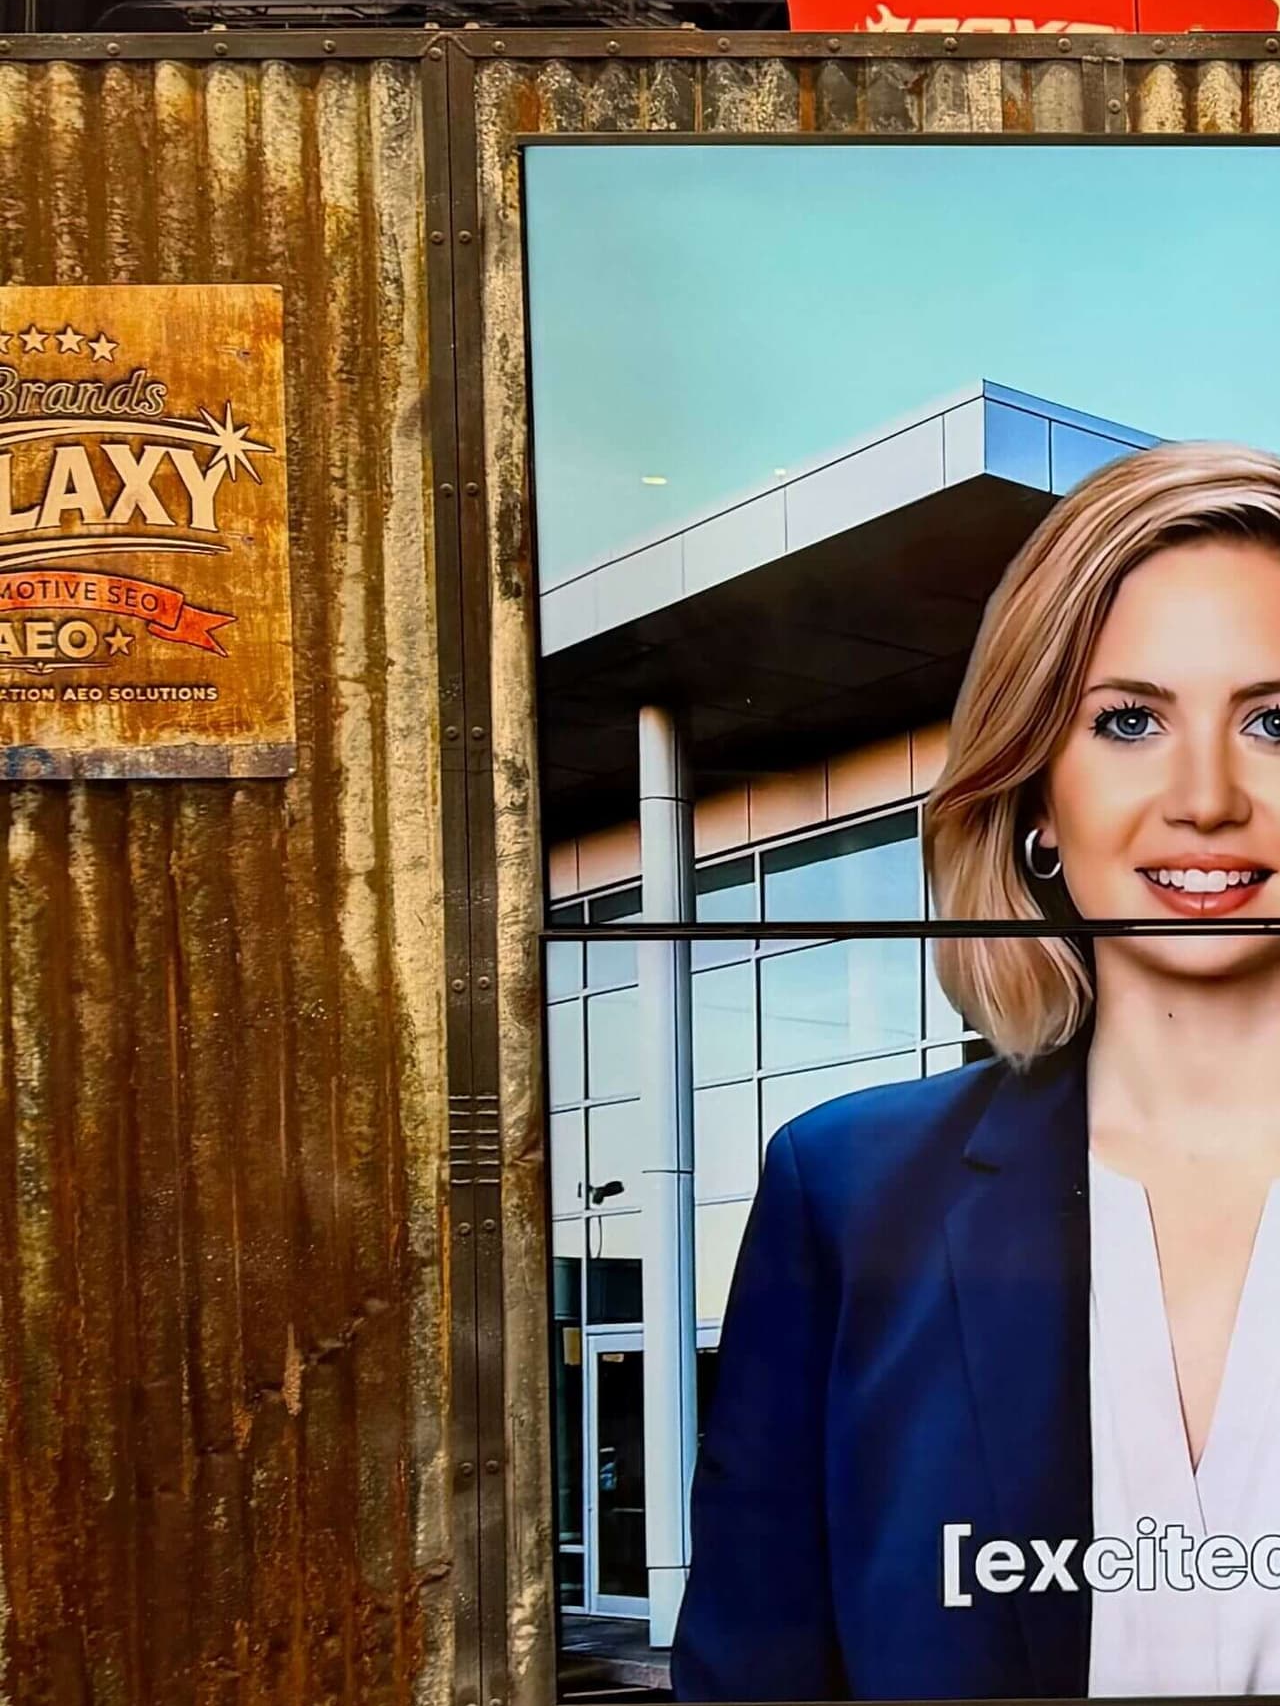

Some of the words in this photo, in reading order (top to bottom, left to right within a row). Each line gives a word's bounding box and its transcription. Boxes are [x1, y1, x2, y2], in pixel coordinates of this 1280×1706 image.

[107, 586, 158, 612] SEO
[63, 688, 103, 701] AEO
[109, 688, 218, 701] SOLUTIONS
